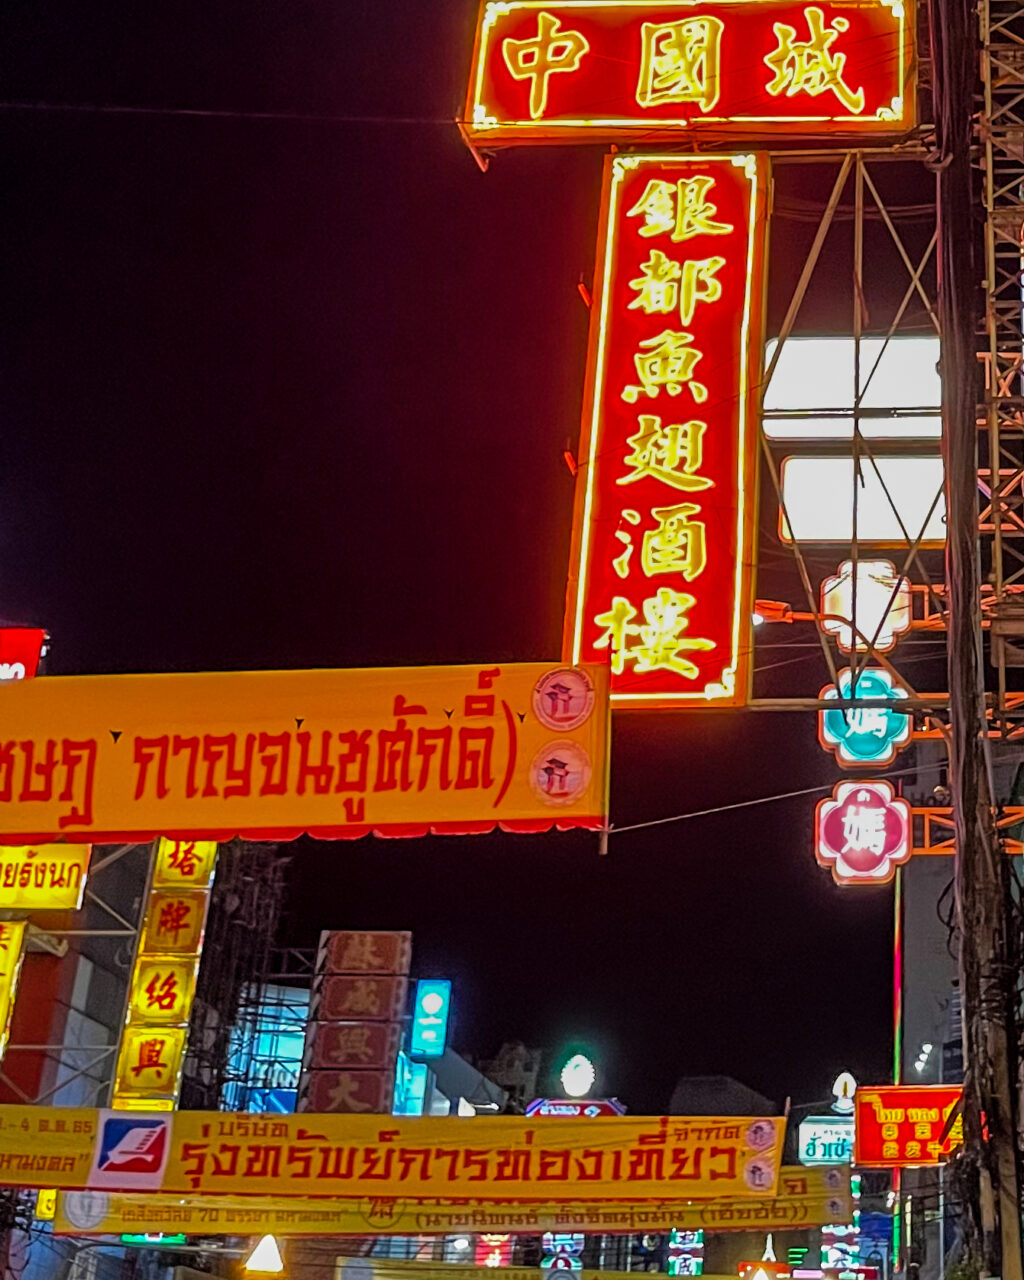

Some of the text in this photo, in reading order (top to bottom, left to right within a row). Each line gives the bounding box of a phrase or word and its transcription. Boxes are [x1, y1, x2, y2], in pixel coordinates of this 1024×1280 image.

[502, 7, 865, 120] 中國城
[593, 174, 734, 680] 銀都魚翅酒樓
[0, 850, 82, 890] ยรังนก
